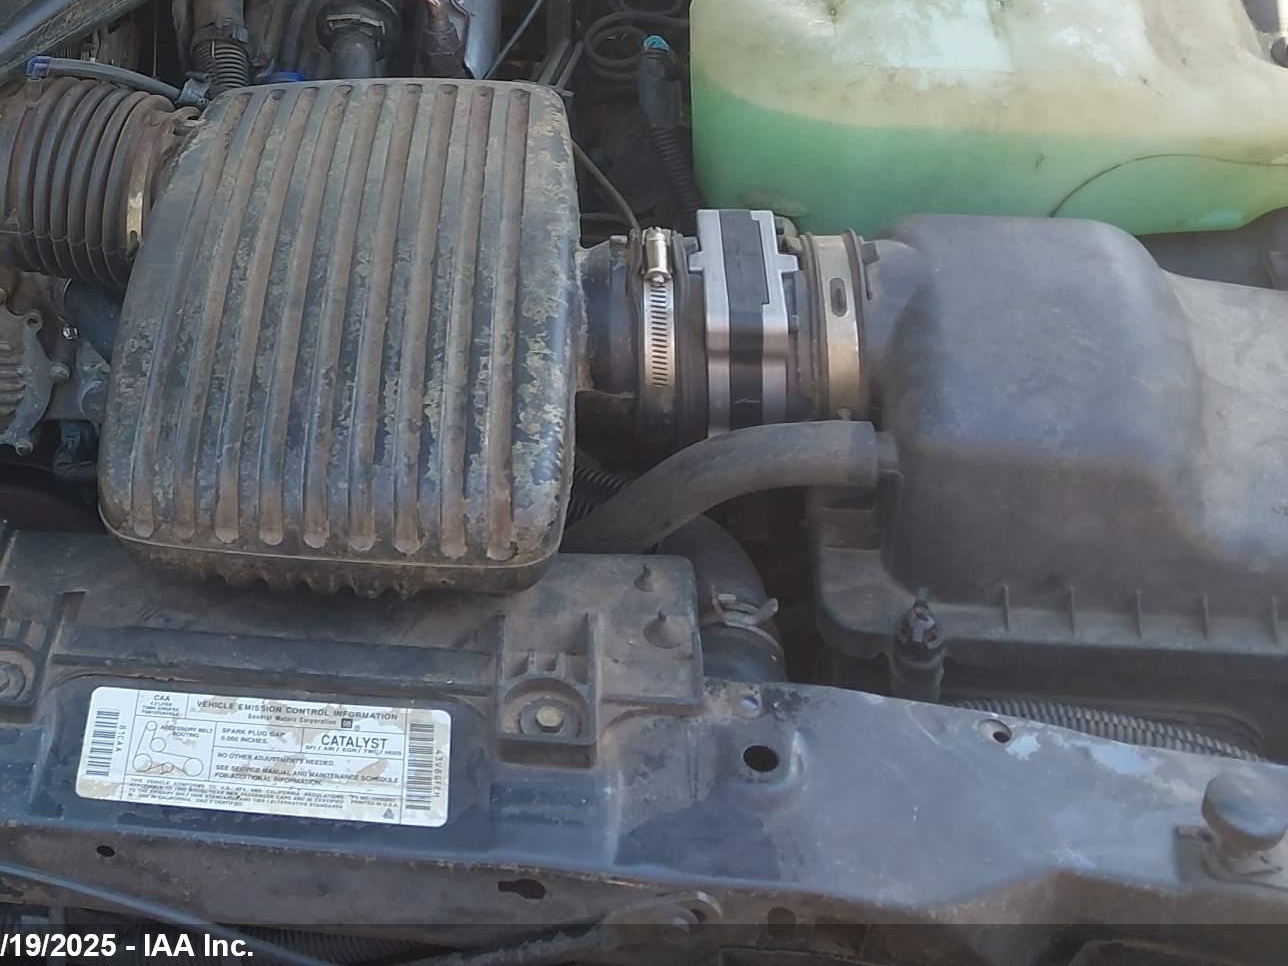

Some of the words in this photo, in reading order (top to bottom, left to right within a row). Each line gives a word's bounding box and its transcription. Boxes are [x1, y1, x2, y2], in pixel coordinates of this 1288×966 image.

[153, 694, 170, 702] CAA
[197, 699, 234, 710] VEHICLE
[238, 703, 282, 714] EMISSION
[285, 707, 330, 717] CONTROL
[333, 710, 398, 721] INFORMATION
[247, 713, 273, 721] General
[274, 715, 297, 724] Motors
[299, 716, 337, 726] Corporation
[160, 724, 197, 732] ACCESSORY
[222, 727, 246, 735] SPARK
[247, 729, 268, 737] PLUG
[172, 730, 200, 738] ROUTING
[321, 734, 389, 749] CATALYST
[253, 754, 305, 764] ADJUSTMENTS
[261, 767, 291, 775] MANUAL
[308, 771, 359, 781] MAINTENANCE
[360, 775, 399, 784] SCHEDULE
